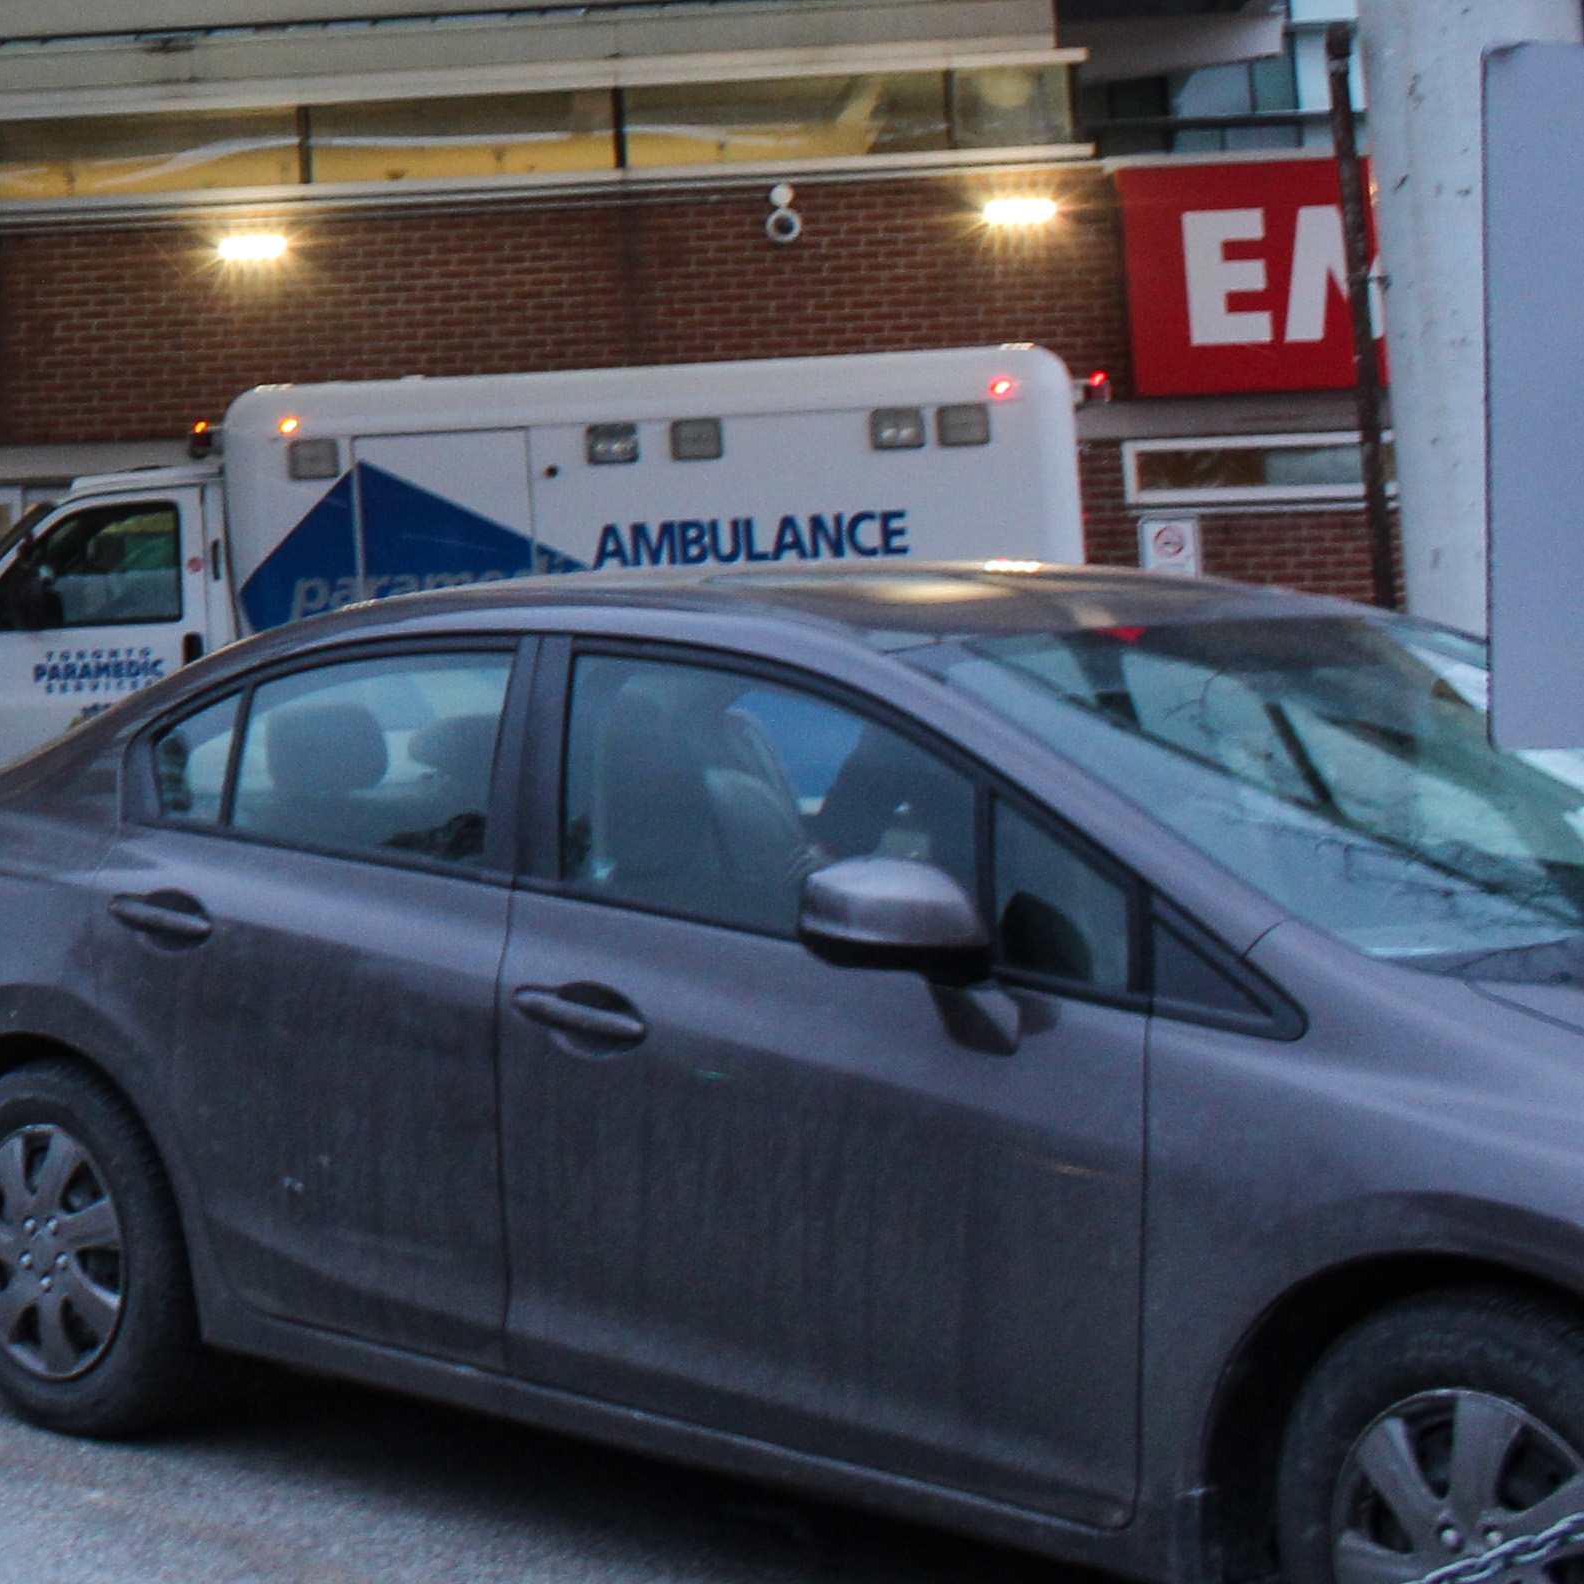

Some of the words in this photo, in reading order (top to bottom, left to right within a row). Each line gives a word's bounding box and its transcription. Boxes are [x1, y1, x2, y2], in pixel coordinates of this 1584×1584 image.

[592, 509, 909, 570] AMBULANCE
[45, 647, 152, 662] TORONTO
[33, 659, 165, 683] PARAMEDIC
